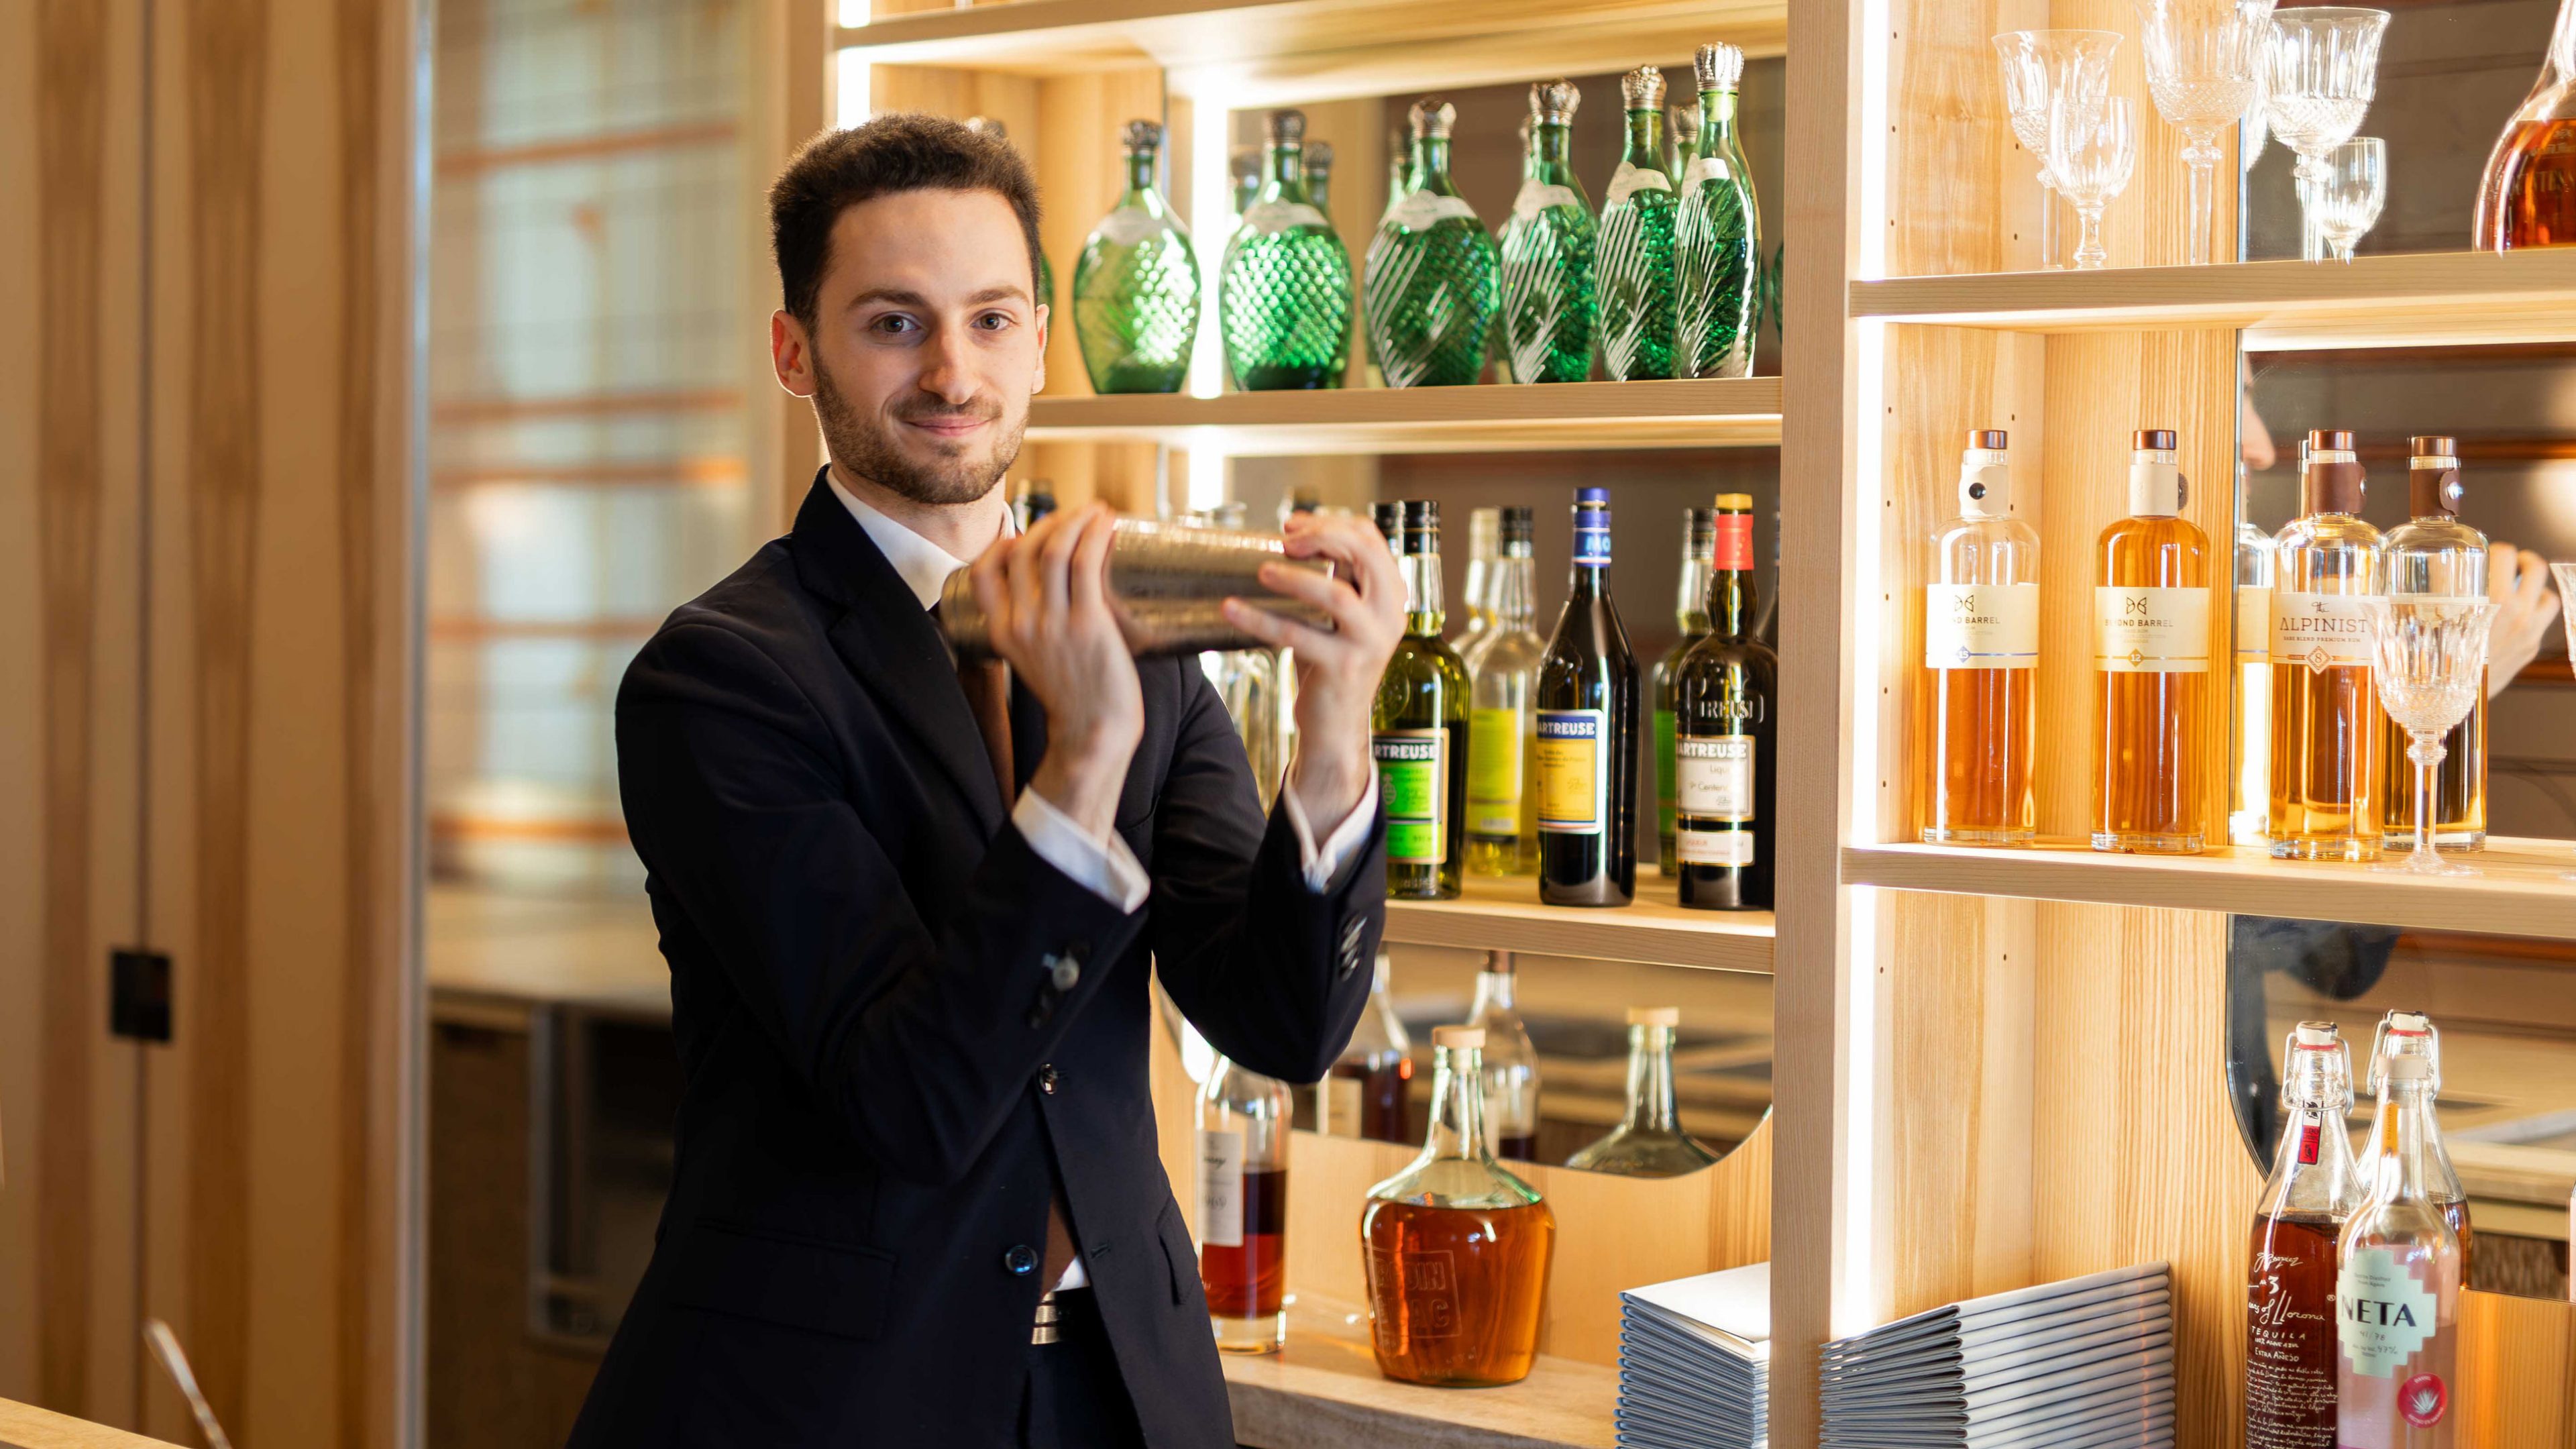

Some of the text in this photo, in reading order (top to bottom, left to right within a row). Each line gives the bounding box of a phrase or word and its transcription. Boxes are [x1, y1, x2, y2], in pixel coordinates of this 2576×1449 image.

[1965, 616, 2000, 625] BARREL
[2138, 619, 2174, 627] BARREL
[2279, 617, 2367, 633] ALPINIST
[2314, 653, 2322, 663] 8
[2342, 1295, 2417, 1327] NETA
[2251, 1326, 2306, 1340] TEQUILA
[2273, 1350, 2300, 1362] AÑEJO
